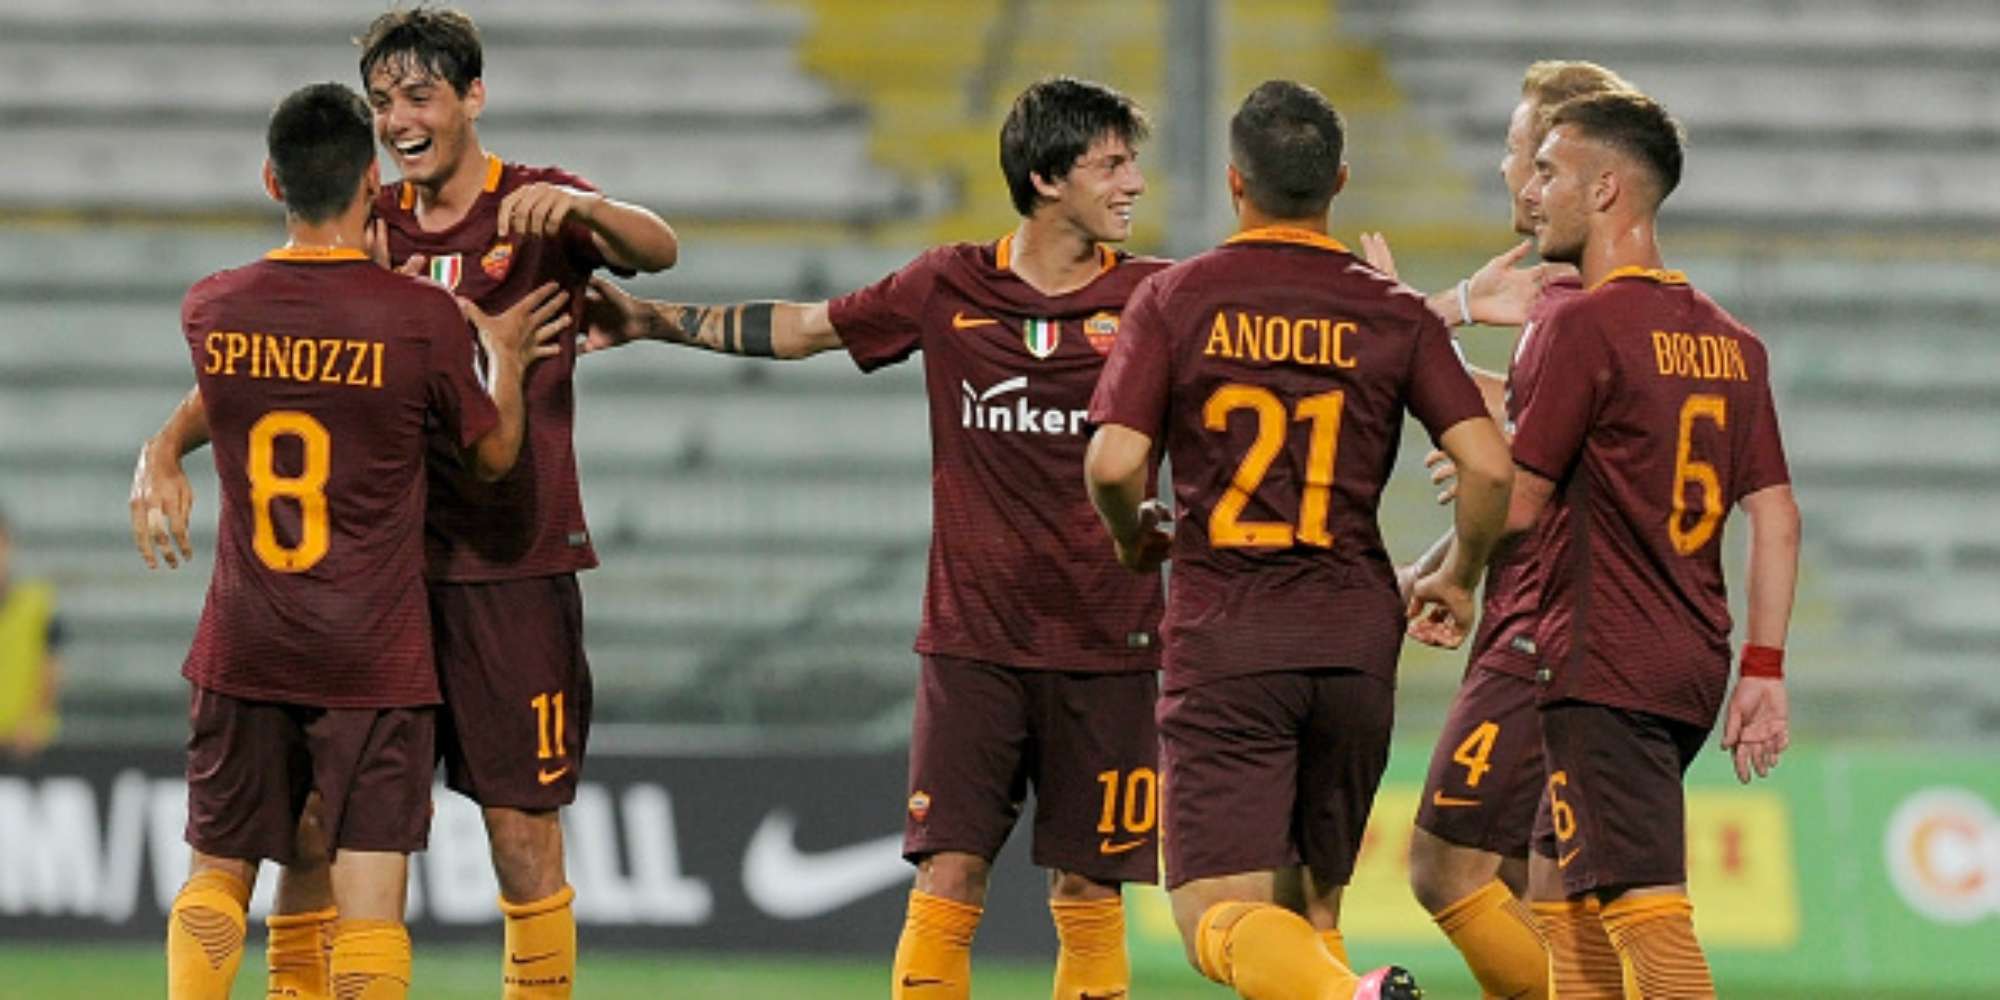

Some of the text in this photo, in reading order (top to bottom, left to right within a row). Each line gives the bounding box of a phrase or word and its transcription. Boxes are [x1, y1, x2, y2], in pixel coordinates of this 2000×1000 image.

[204, 330, 385, 388] SPINOZZI
[1203, 311, 1358, 369] ANOCIC
[1650, 330, 1749, 382] BORDIN
[246, 410, 331, 573] 8
[1203, 383, 1345, 548] 21
[1668, 393, 1727, 556] 6
[530, 691, 566, 759] 11
[1452, 720, 1500, 788] 4
[1097, 767, 1157, 833] 10
[1548, 770, 1577, 842] 6
